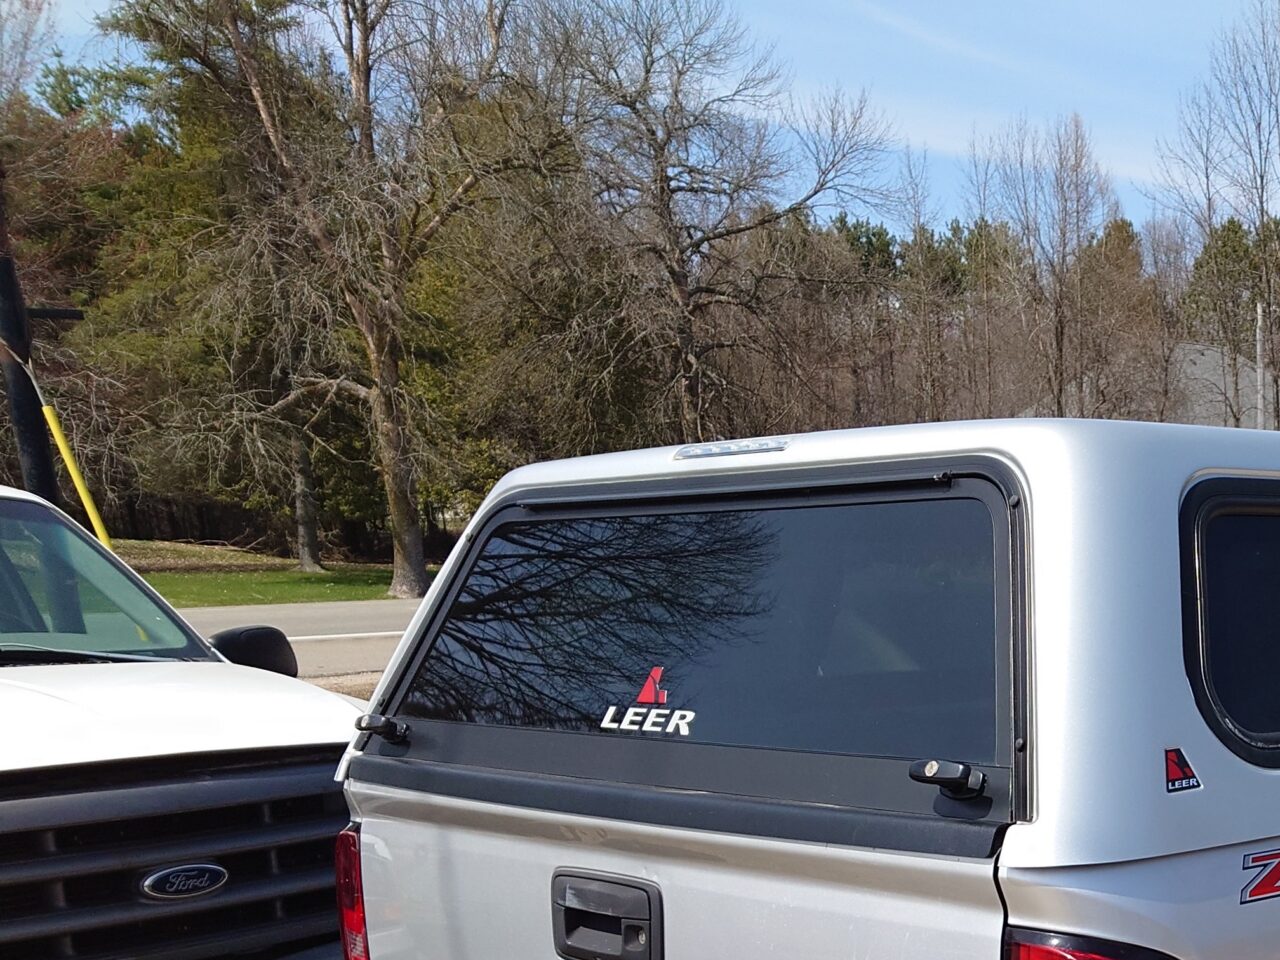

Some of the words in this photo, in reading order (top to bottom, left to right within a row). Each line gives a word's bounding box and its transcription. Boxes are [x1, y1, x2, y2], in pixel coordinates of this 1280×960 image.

[600, 706, 696, 736] LEER
[1168, 778, 1198, 790] LEER
[165, 870, 211, 892] Ford
